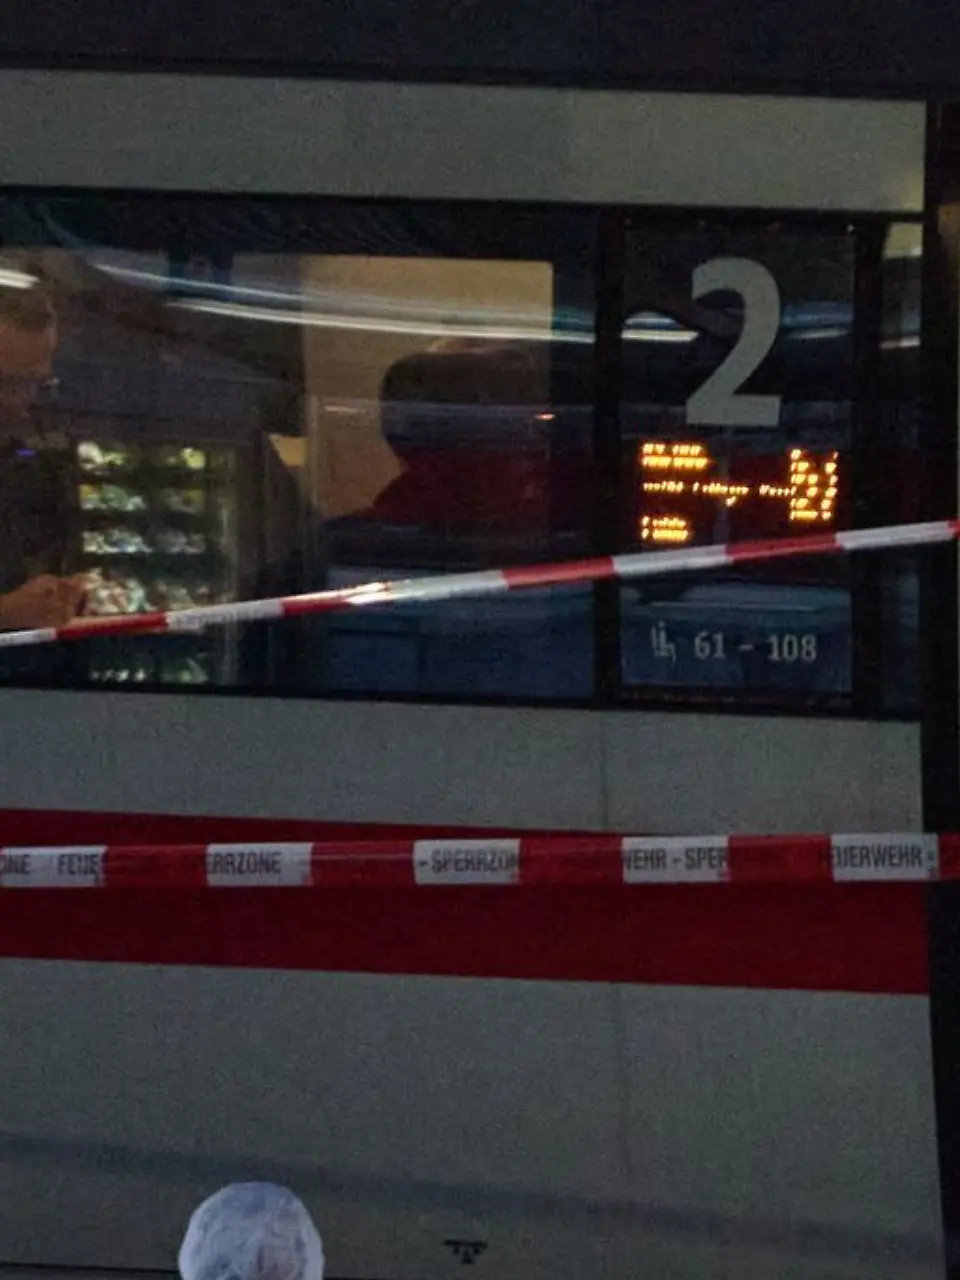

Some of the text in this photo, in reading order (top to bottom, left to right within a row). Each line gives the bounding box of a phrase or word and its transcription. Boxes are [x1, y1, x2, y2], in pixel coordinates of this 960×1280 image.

[686, 256, 781, 427] 2
[694, 629, 726, 660] 61
[767, 633, 818, 662] 108
